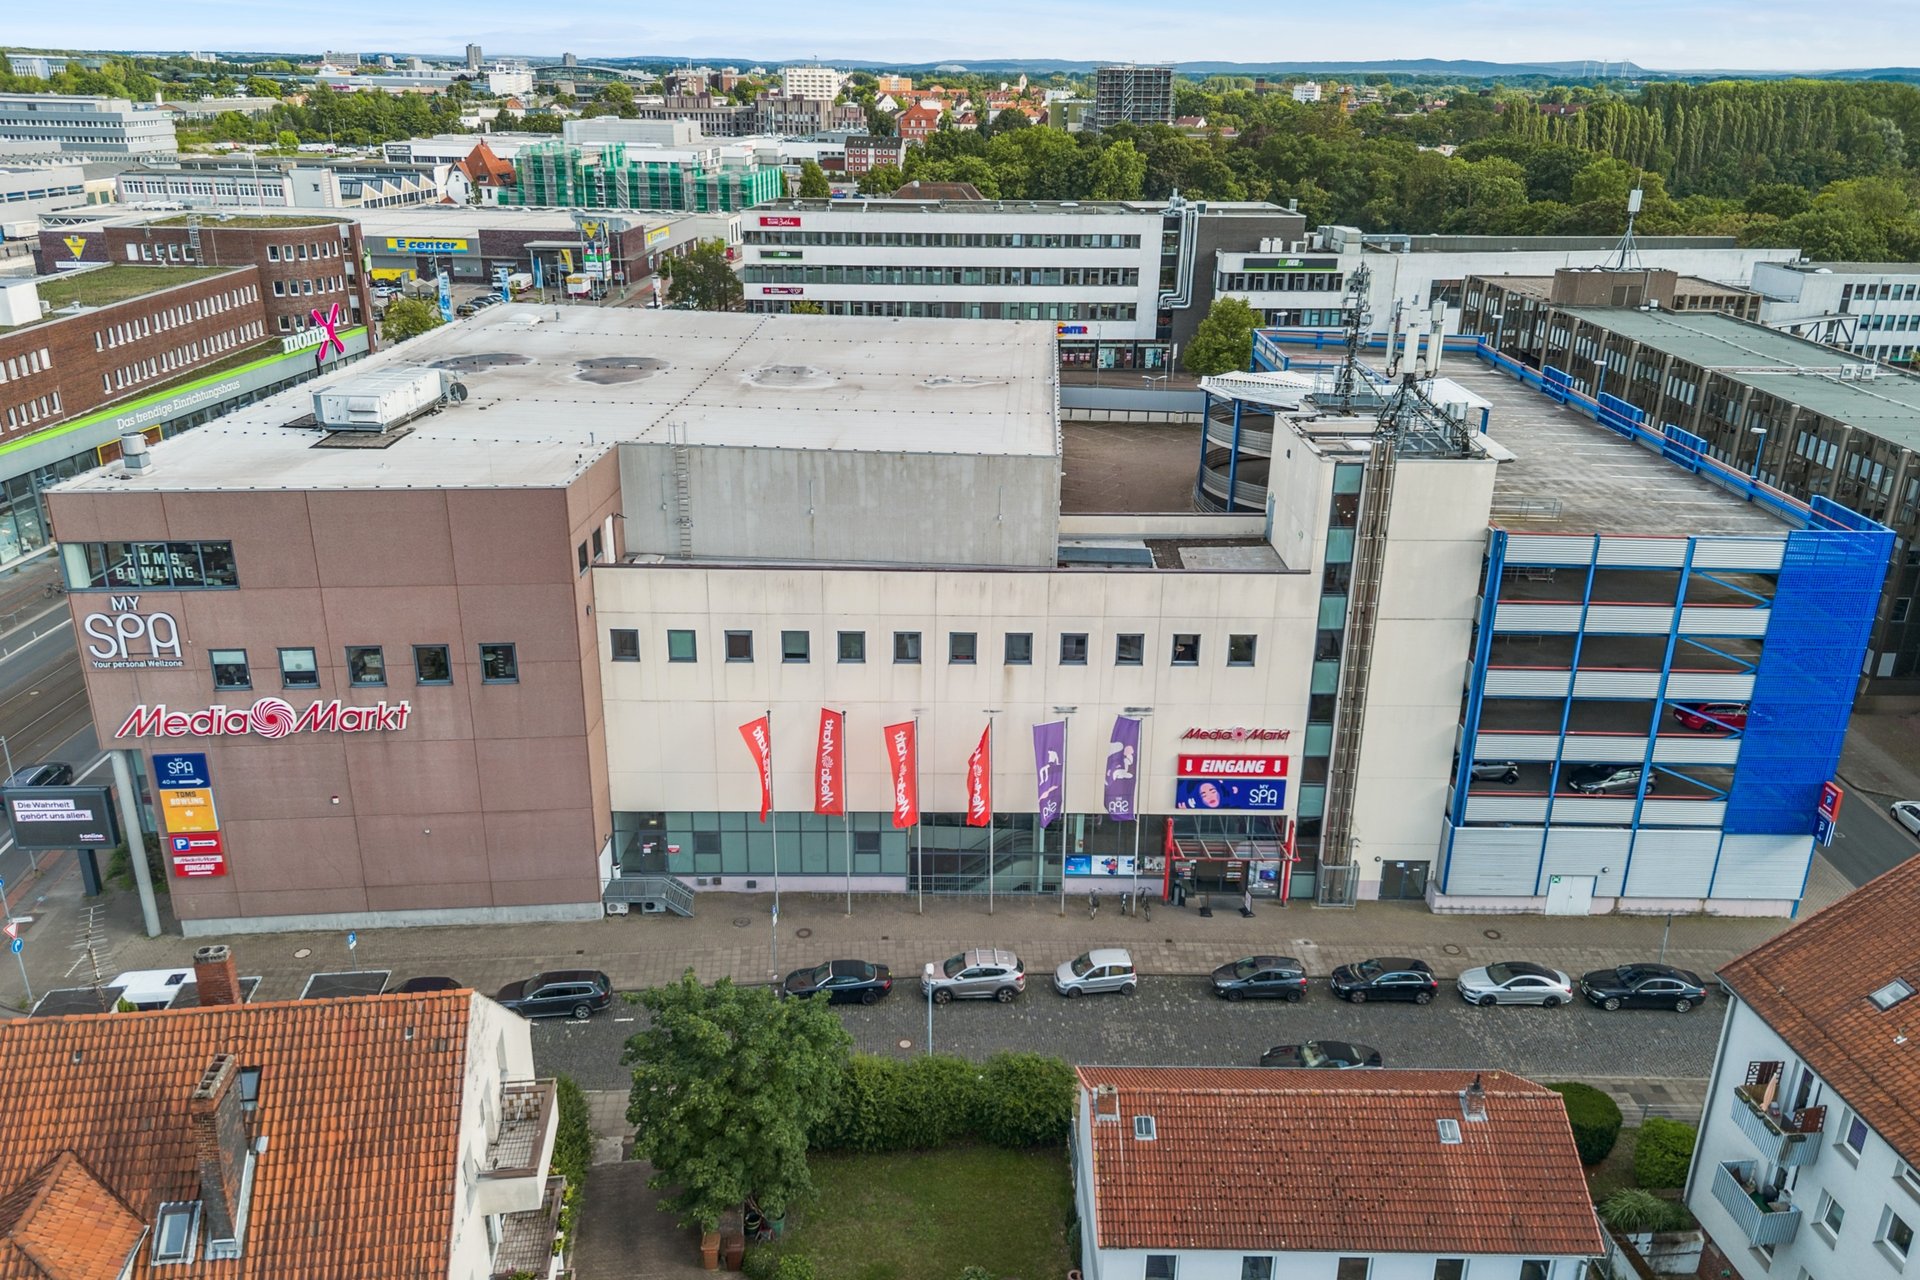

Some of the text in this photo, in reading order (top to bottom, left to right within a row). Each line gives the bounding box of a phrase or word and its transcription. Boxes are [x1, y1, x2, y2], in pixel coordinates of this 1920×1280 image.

[397, 239, 457, 249] E center
[117, 380, 241, 430] Das trendige Einrichtungshaus
[124, 553, 180, 566] TOMS
[116, 567, 195, 580] BOWLING
[110, 596, 140, 611] MY
[84, 612, 182, 659] SPA
[113, 660, 147, 669] personal
[115, 700, 412, 738] Media Markt
[1182, 728, 1290, 741] Media Markt
[167, 761, 194, 774] SPA
[1201, 760, 1266, 773] EINGANG
[1249, 789, 1278, 804] SPA
[20, 813, 48, 821] gehört
[175, 839, 187, 849] P
